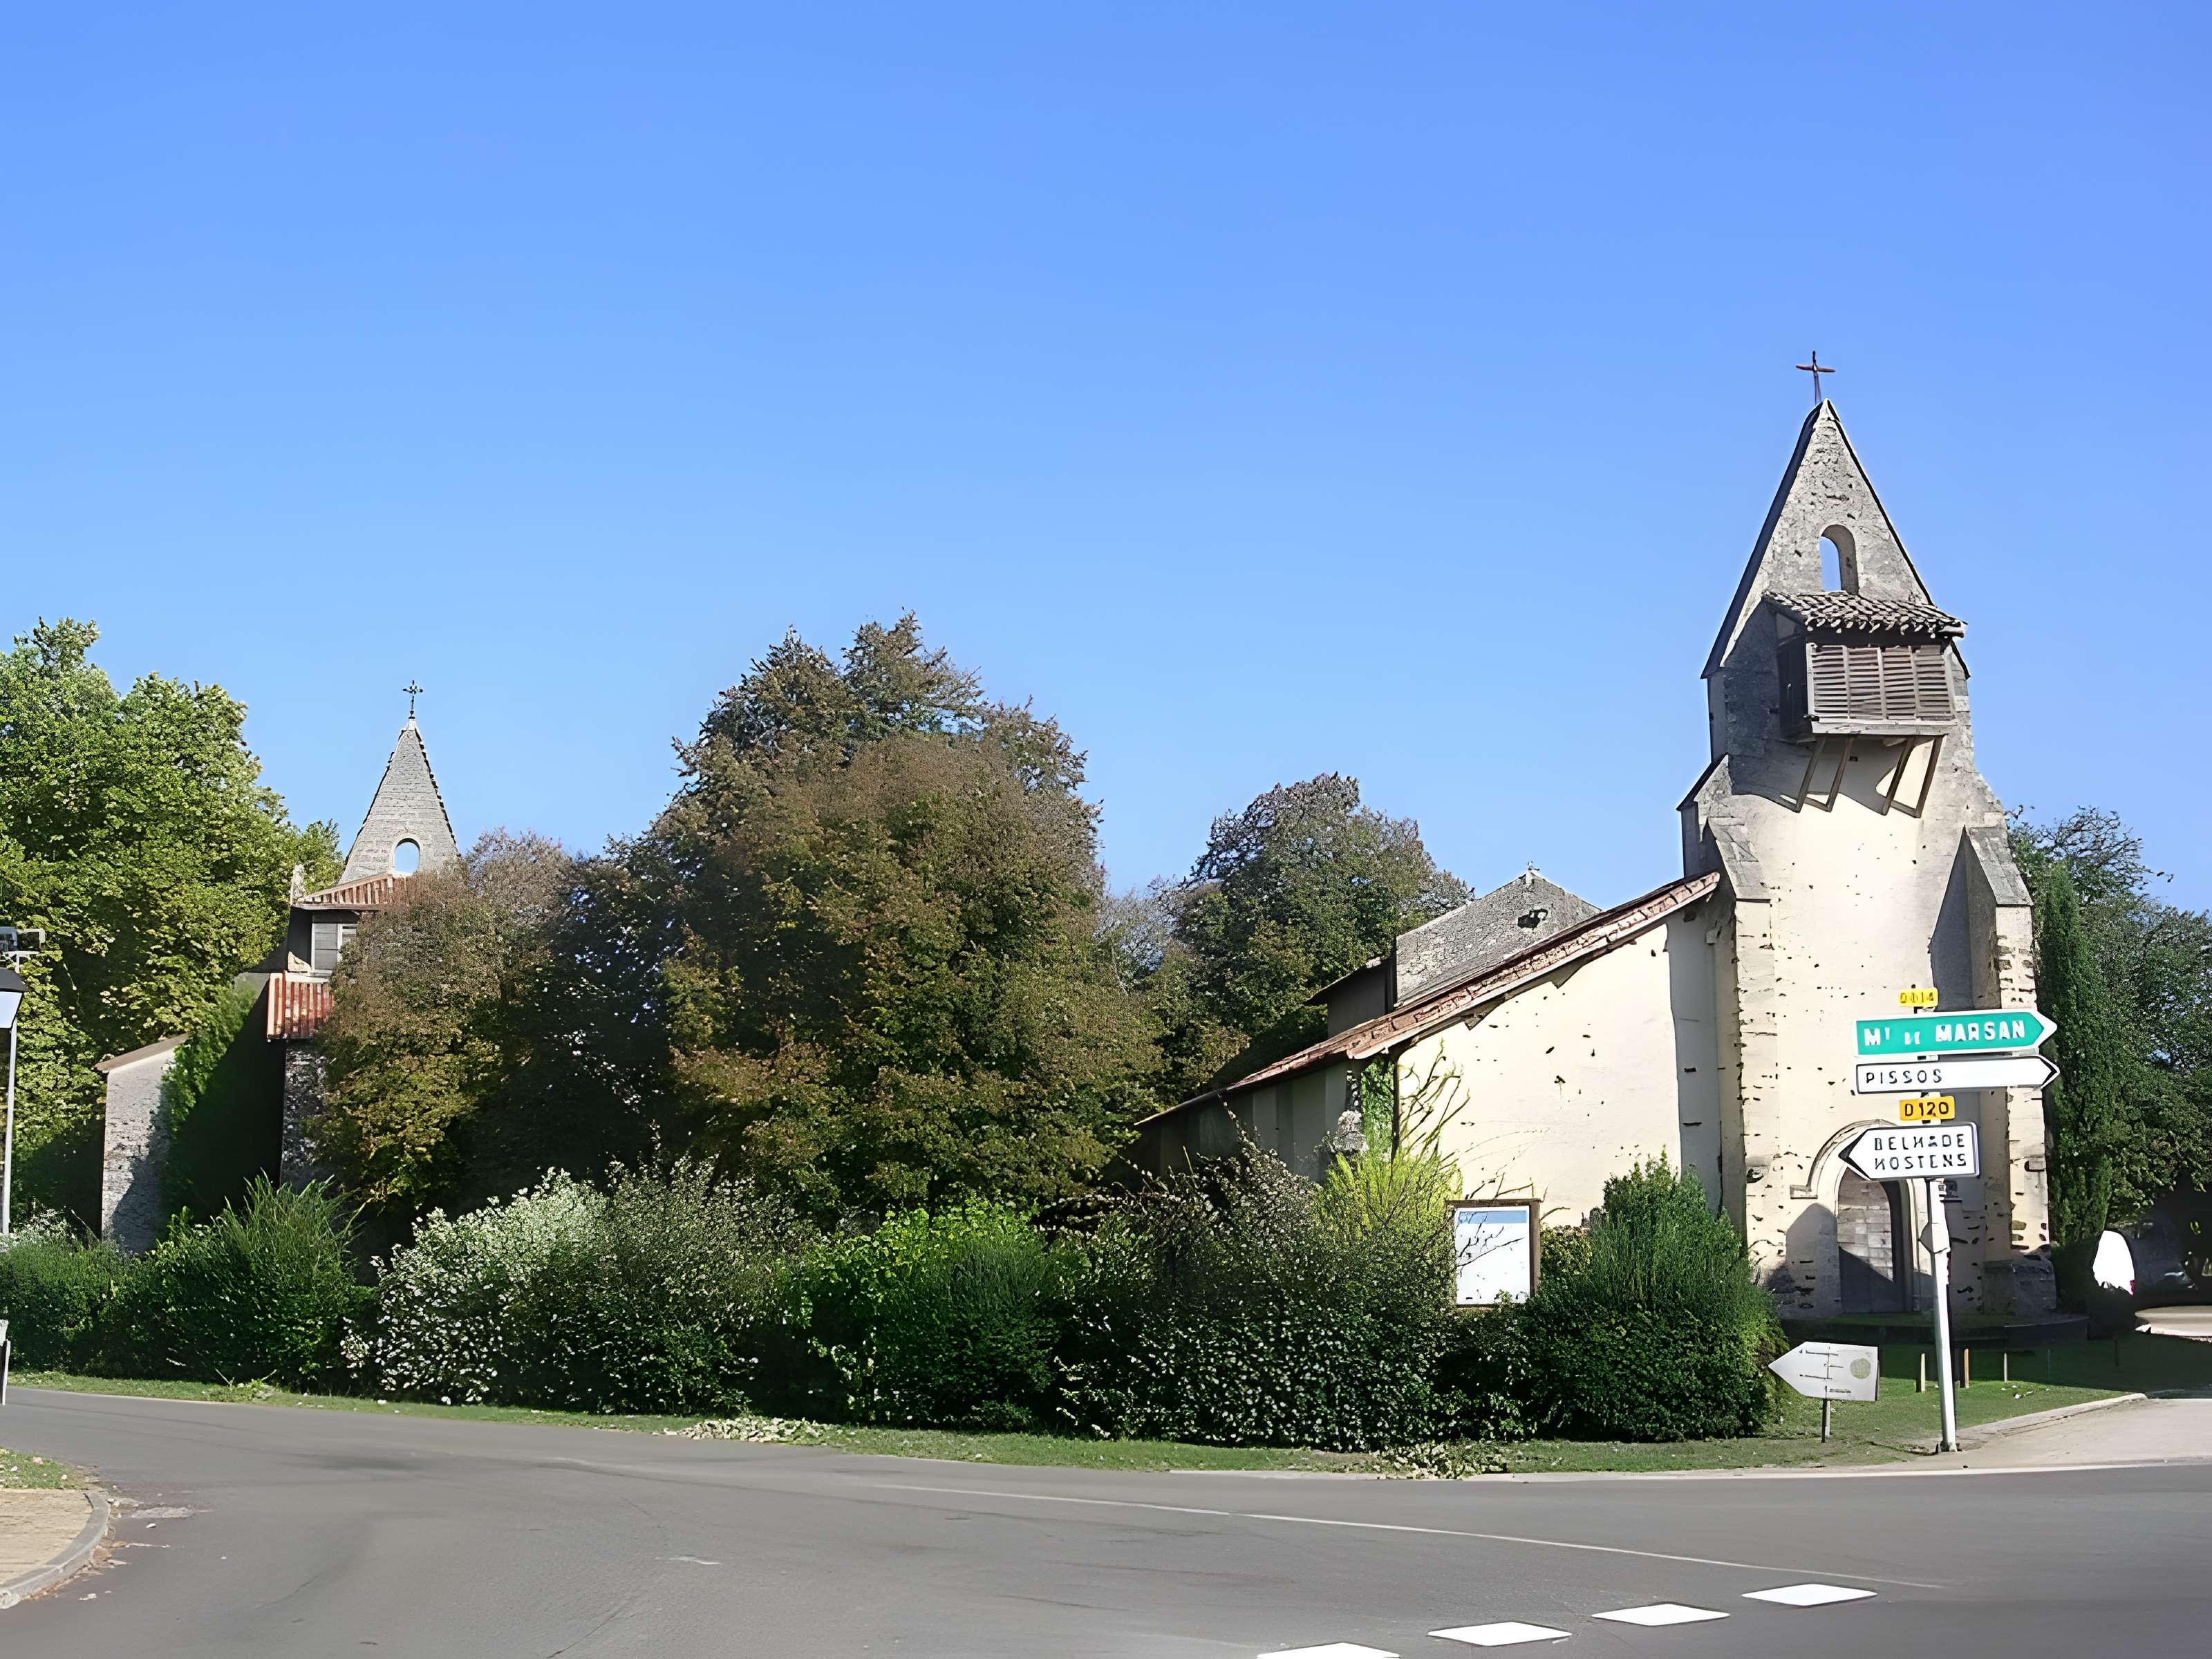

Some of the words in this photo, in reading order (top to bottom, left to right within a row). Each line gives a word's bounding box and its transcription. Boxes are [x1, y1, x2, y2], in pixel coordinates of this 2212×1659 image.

[1936, 1020, 2025, 1042] MARSAN
[1866, 1069, 1942, 1084] PISSOS
[1874, 1134, 1965, 1151] BELHADE
[1875, 1154, 1967, 1170] HOSTENS
